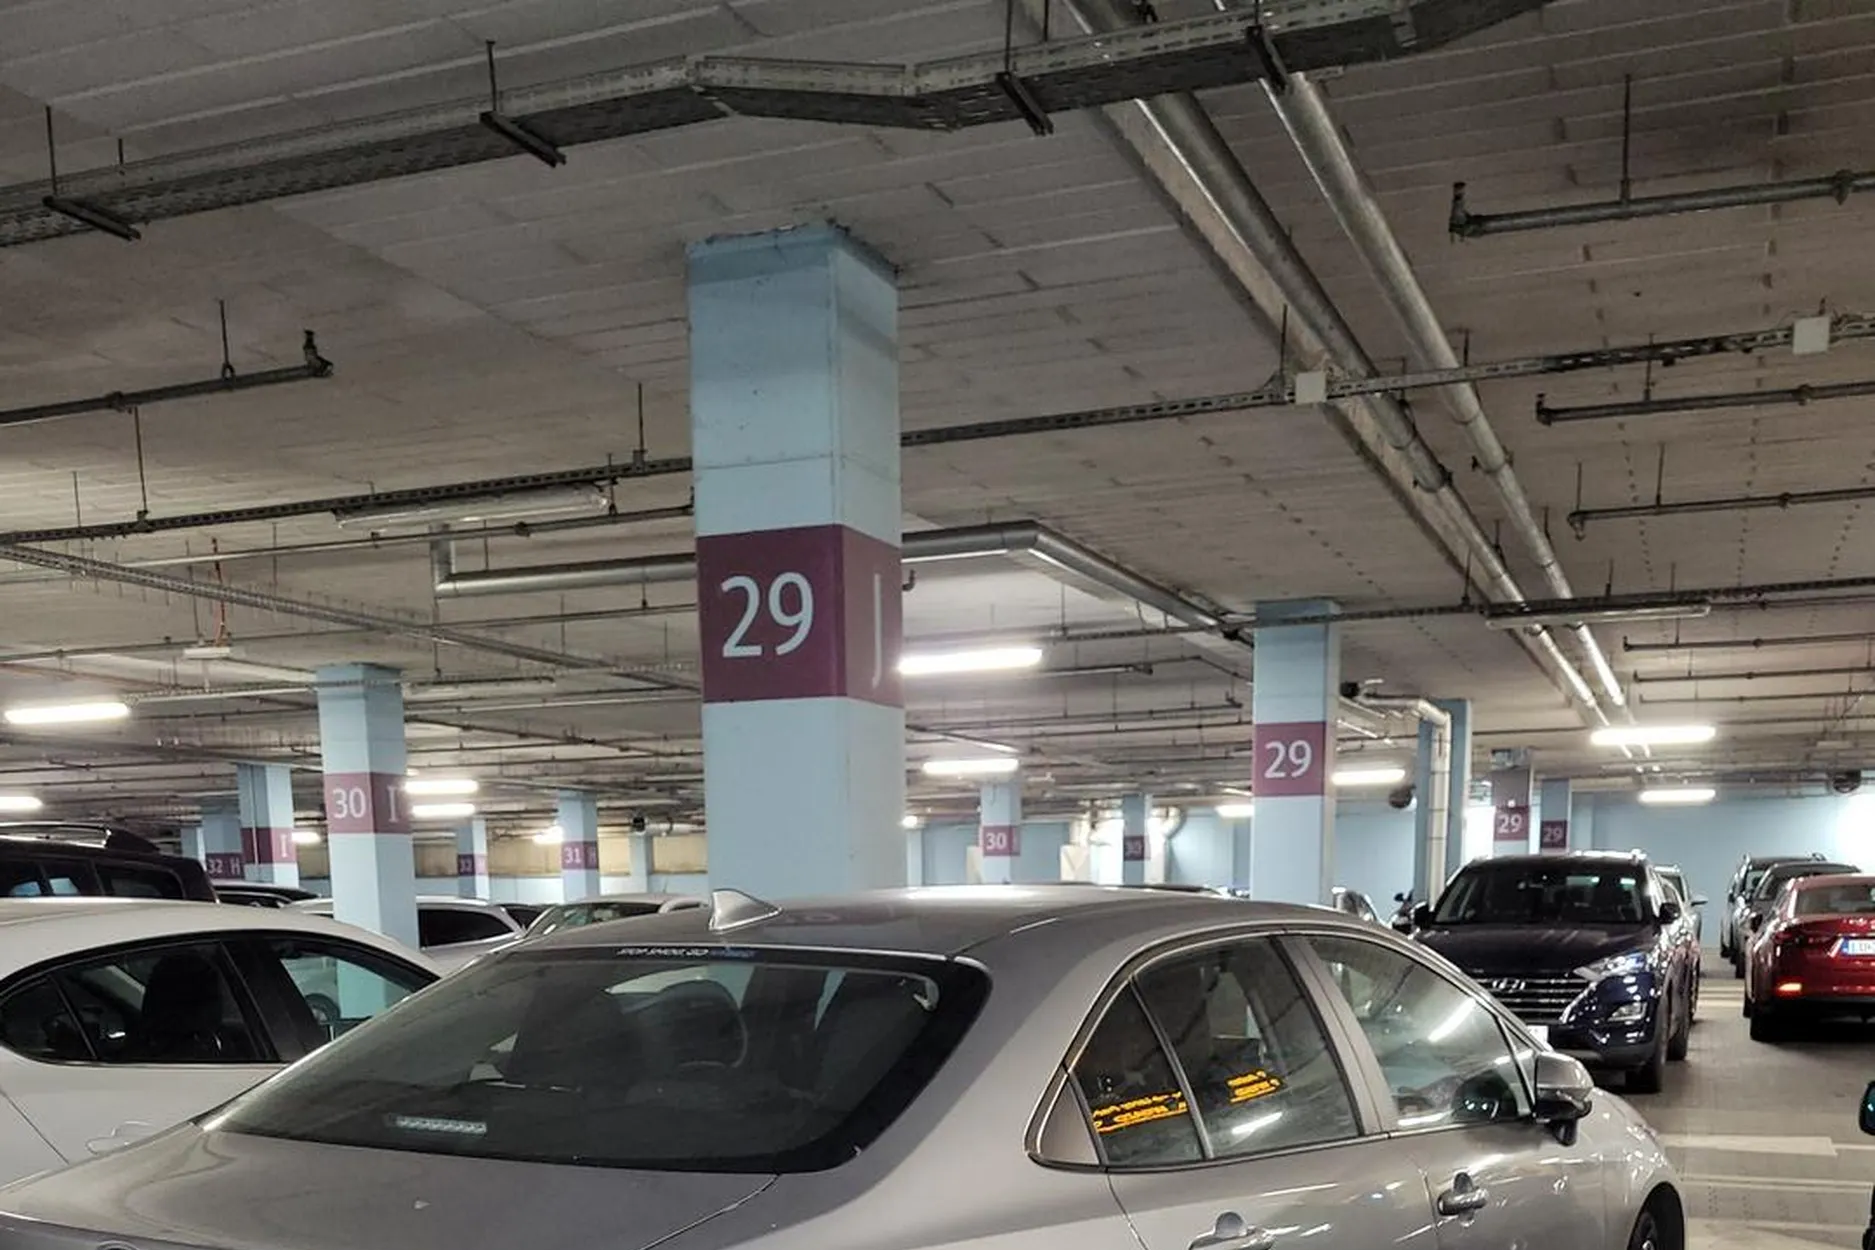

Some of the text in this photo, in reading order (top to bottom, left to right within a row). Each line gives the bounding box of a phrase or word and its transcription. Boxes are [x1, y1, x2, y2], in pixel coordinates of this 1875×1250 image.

[720, 571, 815, 659] 29
[1264, 740, 1312, 779] 29
[332, 787, 367, 819] 30
[386, 785, 400, 823] I
[1497, 813, 1523, 834] 29
[986, 832, 1008, 850] 30
[1542, 827, 1564, 843] 29
[564, 846, 582, 864] 31
[208, 857, 242, 875] 32 H
